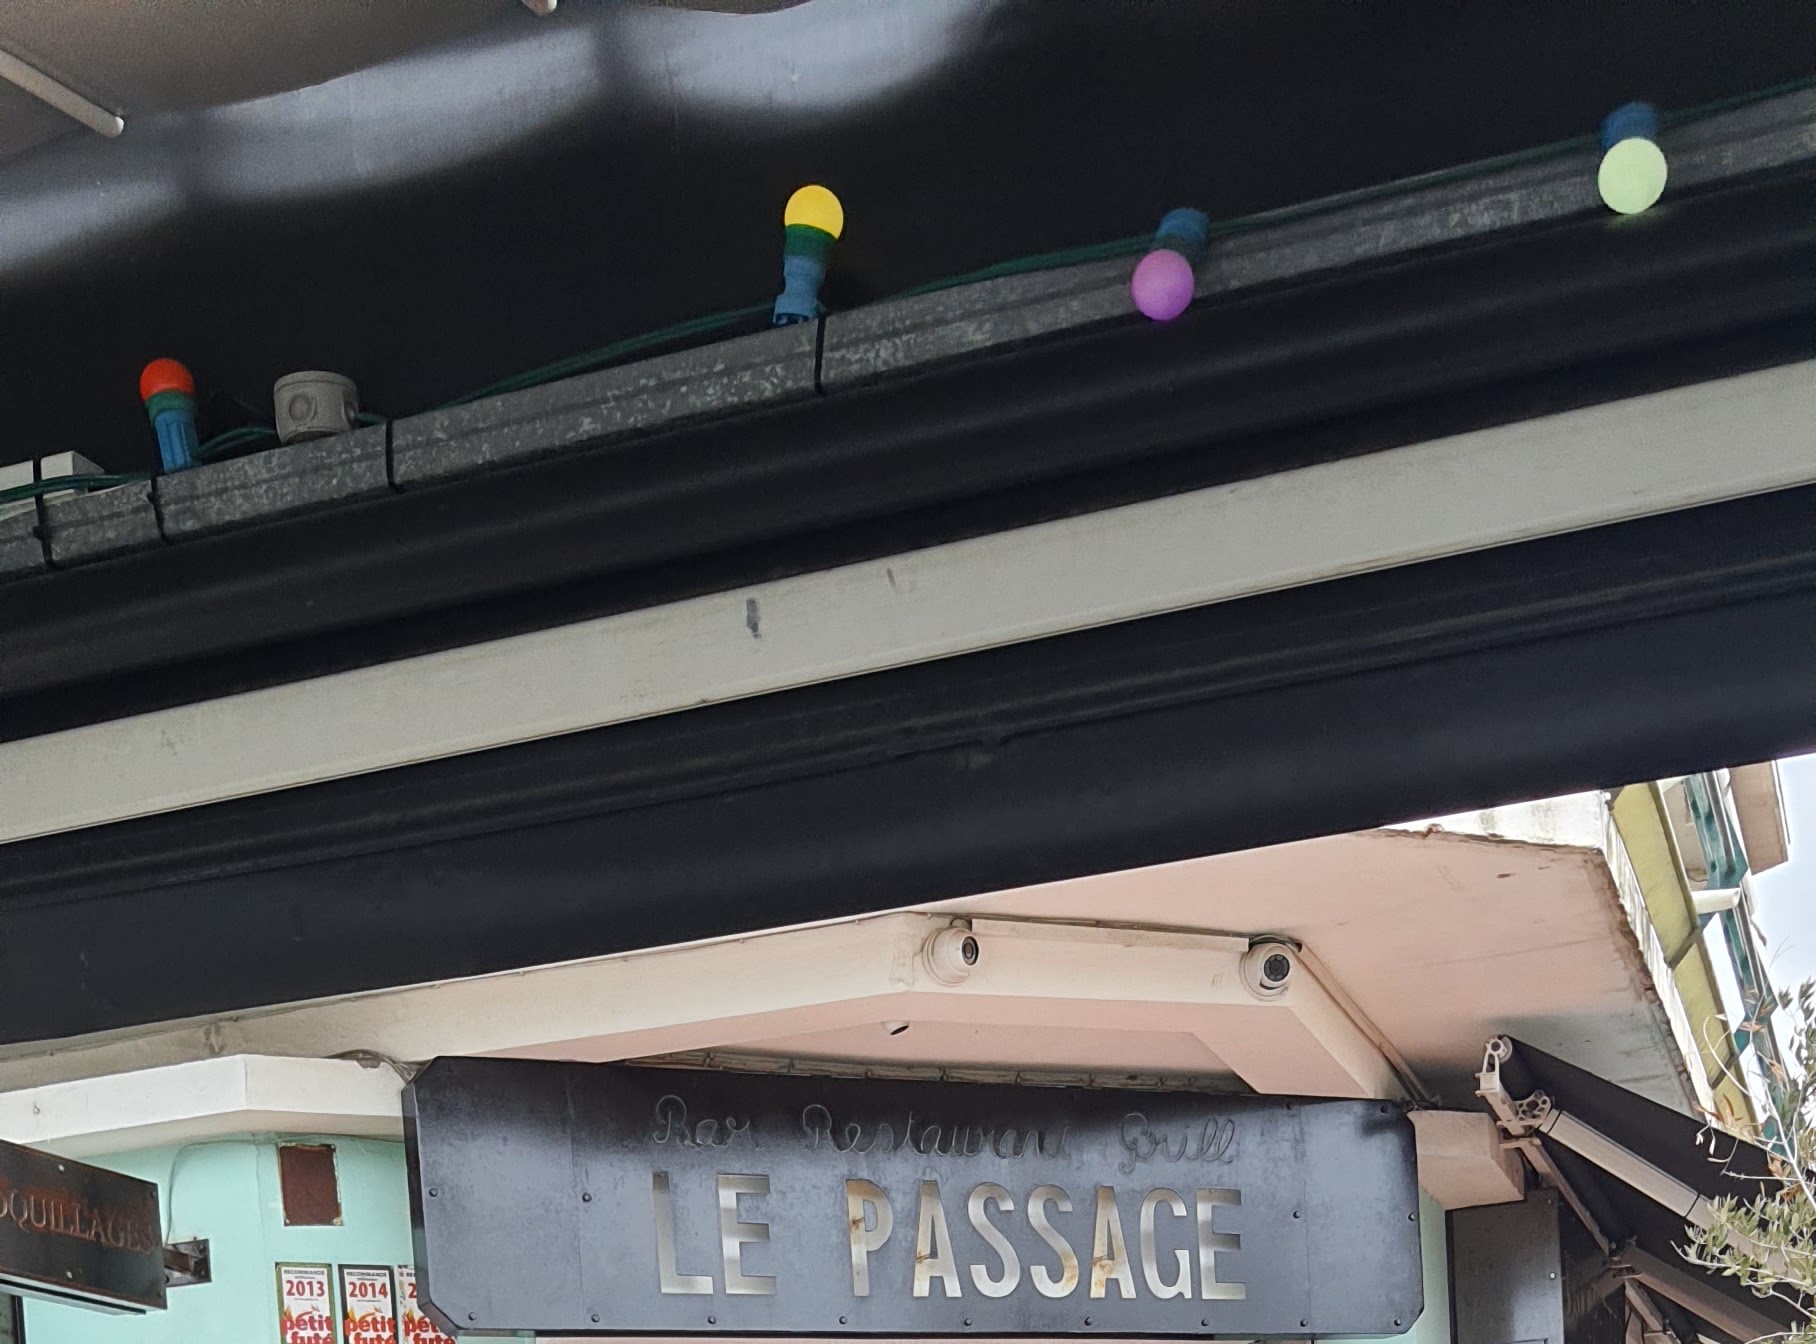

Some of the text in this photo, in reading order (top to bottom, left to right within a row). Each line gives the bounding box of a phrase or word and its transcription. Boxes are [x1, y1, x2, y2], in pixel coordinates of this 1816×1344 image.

[653, 1094, 1236, 1176] Bar Restaurant Grill
[652, 1170, 1247, 1300] LE PASSAGE
[286, 1280, 325, 1297] 2013
[348, 1282, 388, 1298] 2014
[281, 1315, 334, 1337] petit
[344, 1316, 396, 1337] petit
[404, 1316, 438, 1337] pet
